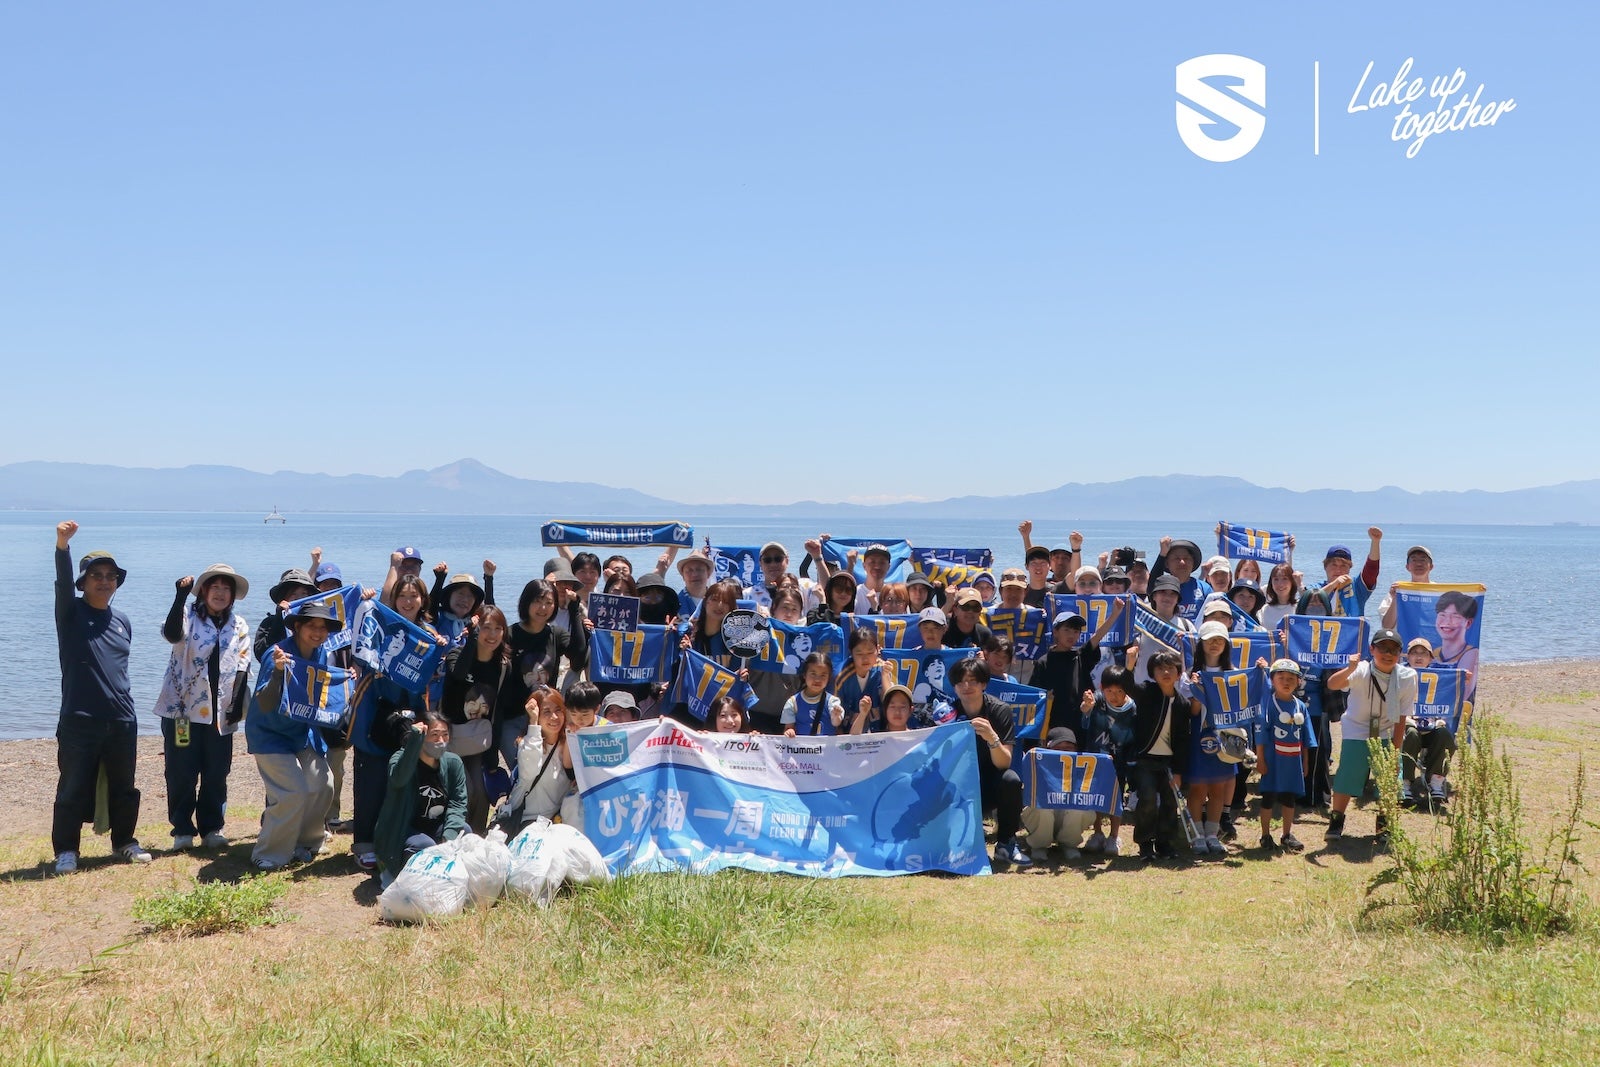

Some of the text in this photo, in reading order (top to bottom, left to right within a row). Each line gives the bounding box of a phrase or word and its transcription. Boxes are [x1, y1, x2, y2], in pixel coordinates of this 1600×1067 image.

[586, 528, 653, 542] SHIGA LAKES
[1245, 528, 1271, 550] 17
[323, 593, 347, 629] 7
[597, 605, 631, 618] ありが
[1076, 599, 1107, 632] 17
[874, 619, 907, 649] 17
[1309, 619, 1341, 653] 17
[610, 630, 645, 667] 17
[1230, 637, 1251, 669] 7
[1297, 653, 1318, 664] KOHEI
[394, 661, 421, 683] TSUNETA
[404, 653, 424, 670] KOHEI
[305, 665, 331, 710] 17
[696, 662, 736, 707] 17
[1212, 673, 1249, 712] 17
[1414, 672, 1438, 704] 7
[290, 701, 313, 718] KOHEI
[1213, 713, 1232, 725] OHEI
[1420, 704, 1450, 715] TSUNETA
[583, 738, 623, 748] Rethink
[786, 745, 821, 755] hummel
[800, 763, 822, 771] MALL
[1059, 754, 1098, 793] 17
[1046, 792, 1070, 805] KOHEI
[598, 788, 764, 840] びわ湖一周
[771, 812, 800, 826] AROUND
